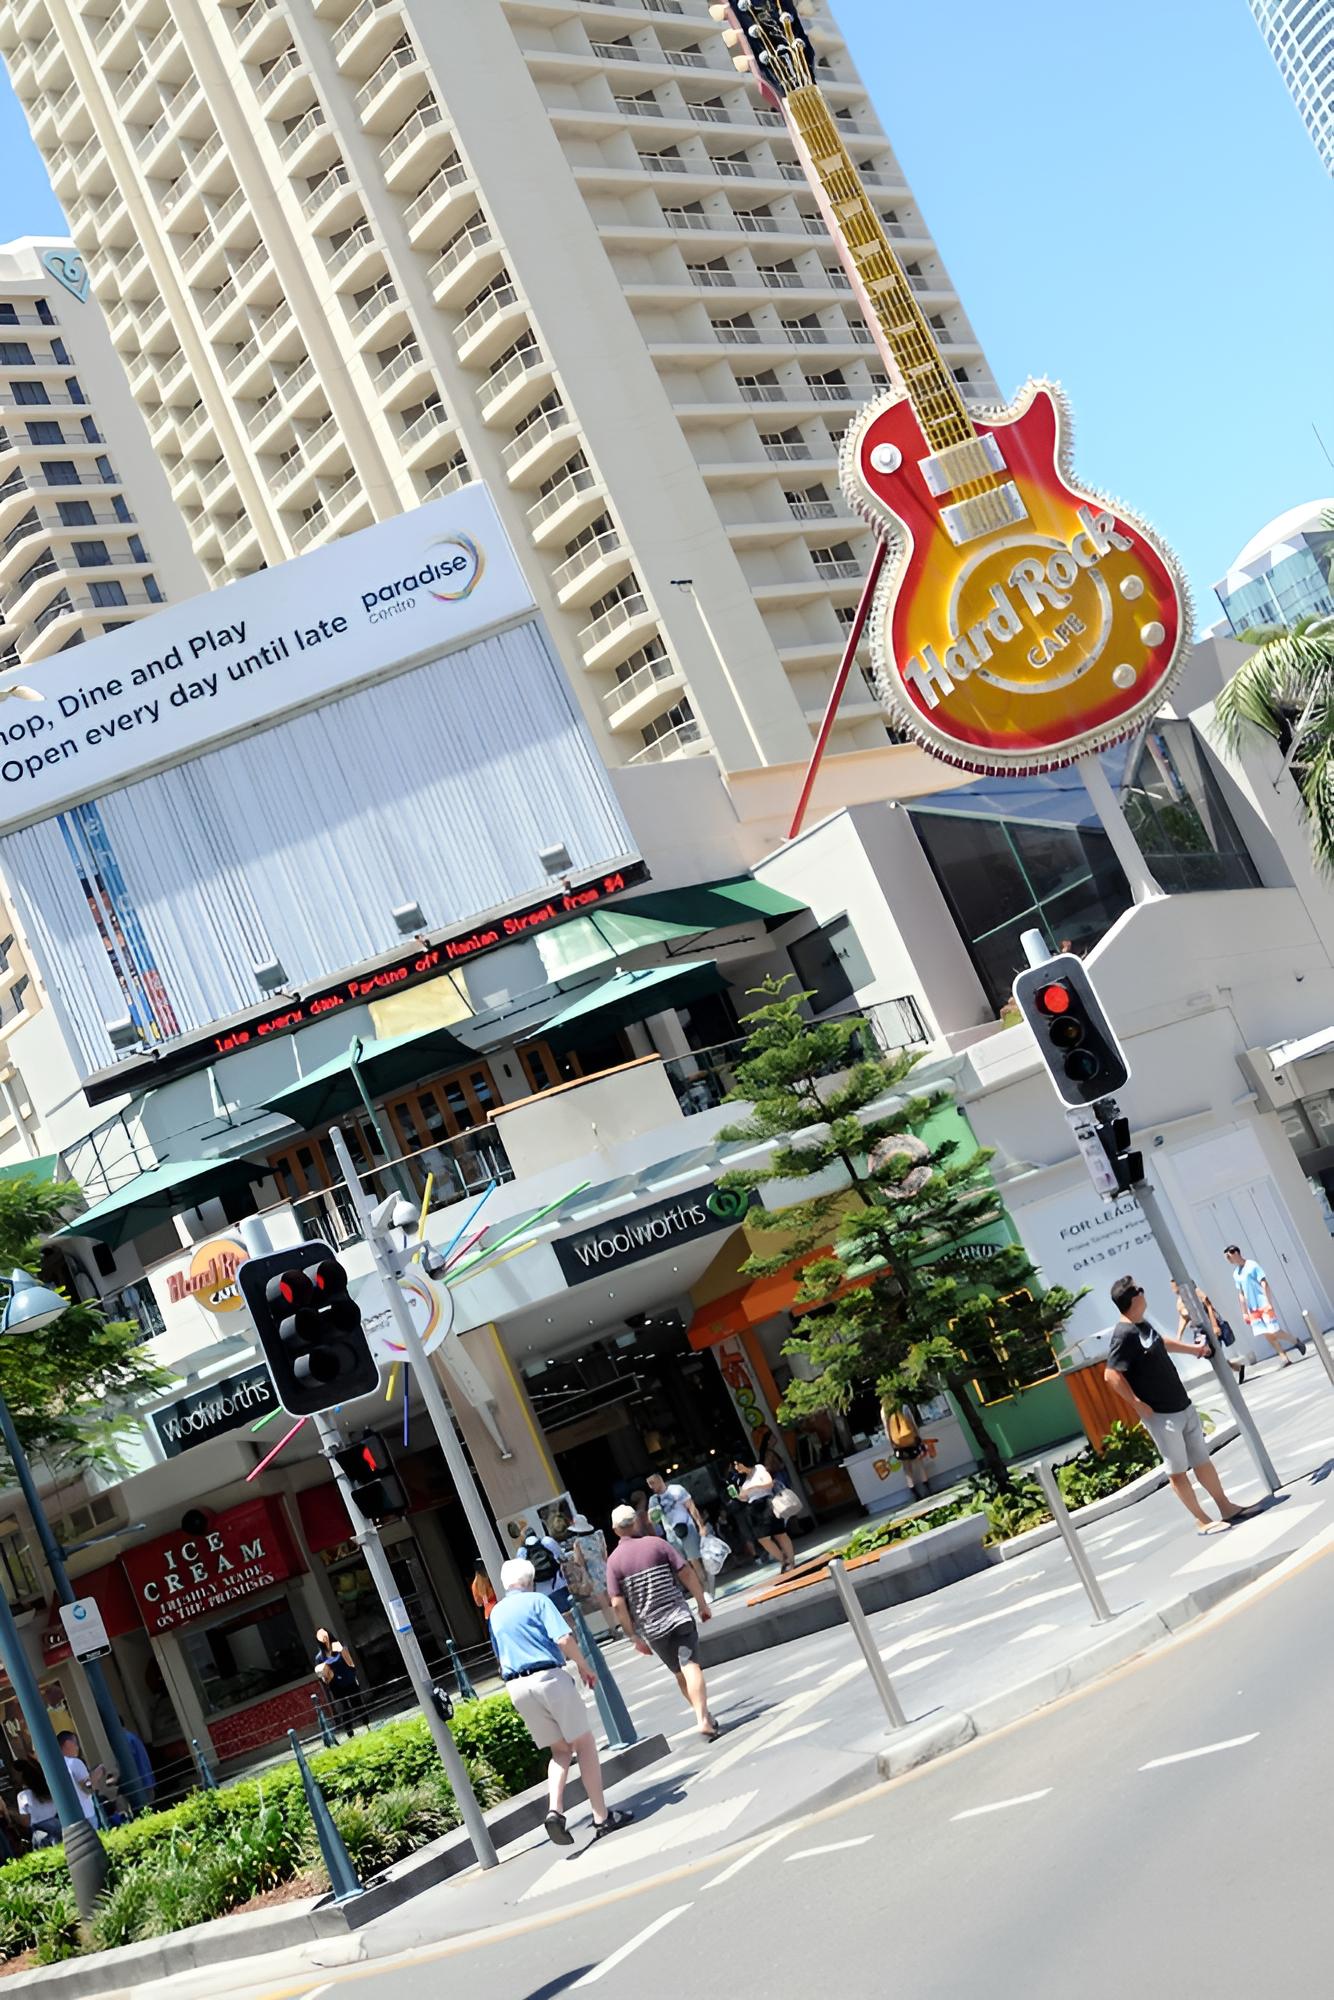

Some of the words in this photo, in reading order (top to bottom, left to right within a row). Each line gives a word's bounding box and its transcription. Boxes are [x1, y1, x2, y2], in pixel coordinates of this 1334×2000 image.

[361, 556, 467, 612] paradise
[904, 582, 1024, 710] Hard
[1008, 504, 1134, 617] Rock
[58, 679, 123, 718] Dine
[130, 646, 184, 686] and
[188, 620, 246, 659] Play
[1027, 612, 1087, 668] CAFE
[1, 739, 79, 782] Open
[85, 699, 159, 745] every
[169, 673, 217, 707] day
[227, 637, 290, 681] until
[294, 616, 348, 651] late
[1060, 1220, 1091, 1240] FOR
[144, 1538, 266, 1601] CREAM
[164, 1532, 224, 1570] ICE
